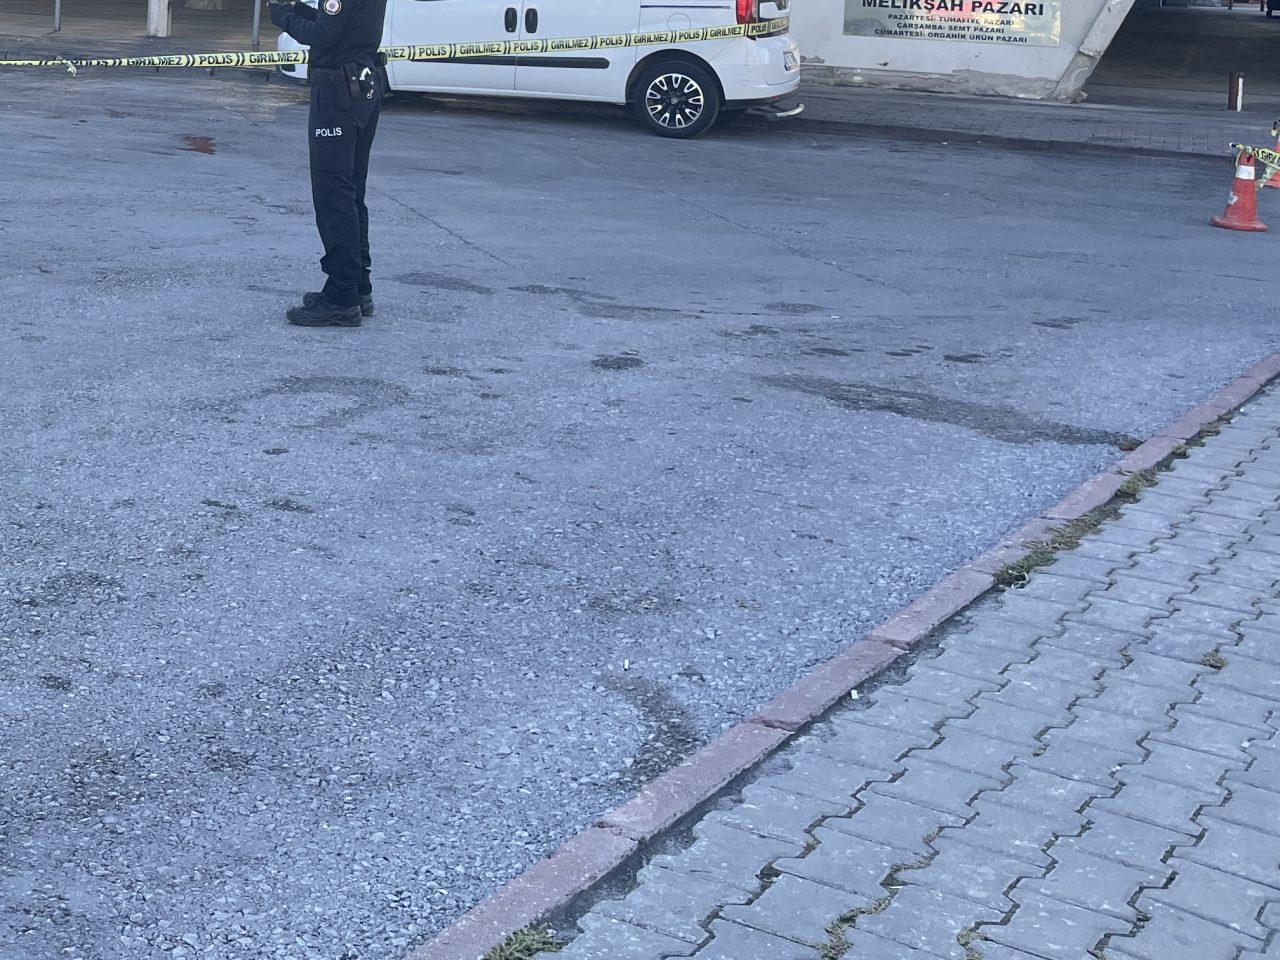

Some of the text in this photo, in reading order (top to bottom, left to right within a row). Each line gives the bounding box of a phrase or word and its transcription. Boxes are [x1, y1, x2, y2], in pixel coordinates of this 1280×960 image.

[971, 0, 1044, 16] PAZARI
[948, 24, 972, 32] SEMT
[973, 26, 1005, 34] PAZARI
[996, 35, 1027, 43] PAZARI
